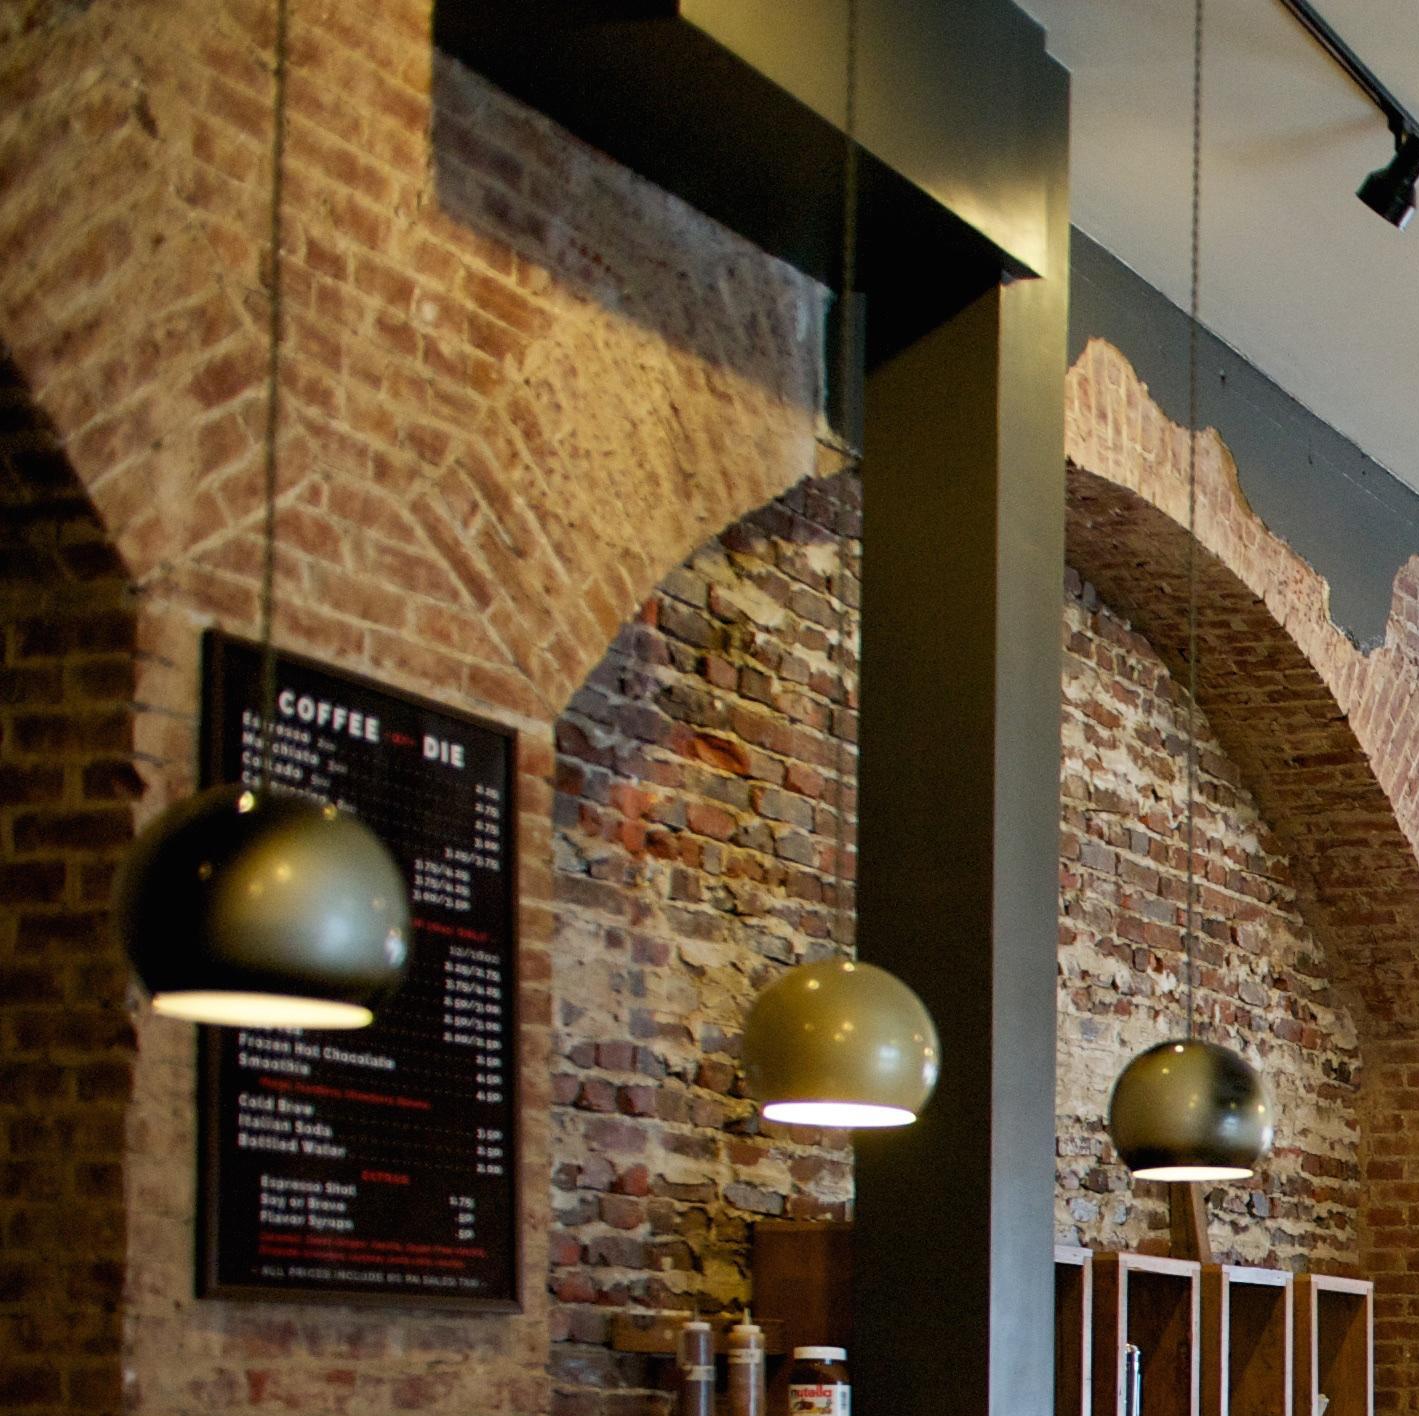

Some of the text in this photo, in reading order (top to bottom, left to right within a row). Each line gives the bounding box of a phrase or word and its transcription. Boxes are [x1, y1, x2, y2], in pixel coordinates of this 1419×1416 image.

[278, 690, 380, 743] COFFEE
[423, 735, 465, 768] DIE
[242, 731, 320, 766] Machiato
[239, 1032, 291, 1053] Frozen
[294, 1041, 321, 1057] Hot
[322, 1047, 396, 1070] Chocolate
[239, 1053, 311, 1075] Smoothie
[239, 1093, 274, 1111] Cold
[277, 1098, 315, 1116] Brew
[239, 1112, 292, 1131] Italian
[294, 1120, 333, 1137] Soda
[238, 1132, 299, 1152] Bottled
[302, 1140, 347, 1159] Water
[260, 1175, 323, 1193] Espresso
[325, 1182, 357, 1196] Shot
[260, 1193, 287, 1208] Soy
[289, 1198, 305, 1208] or
[260, 1210, 306, 1226] Flavor
[307, 1215, 354, 1231] Syrups
[790, 1384, 832, 1398] nutella
